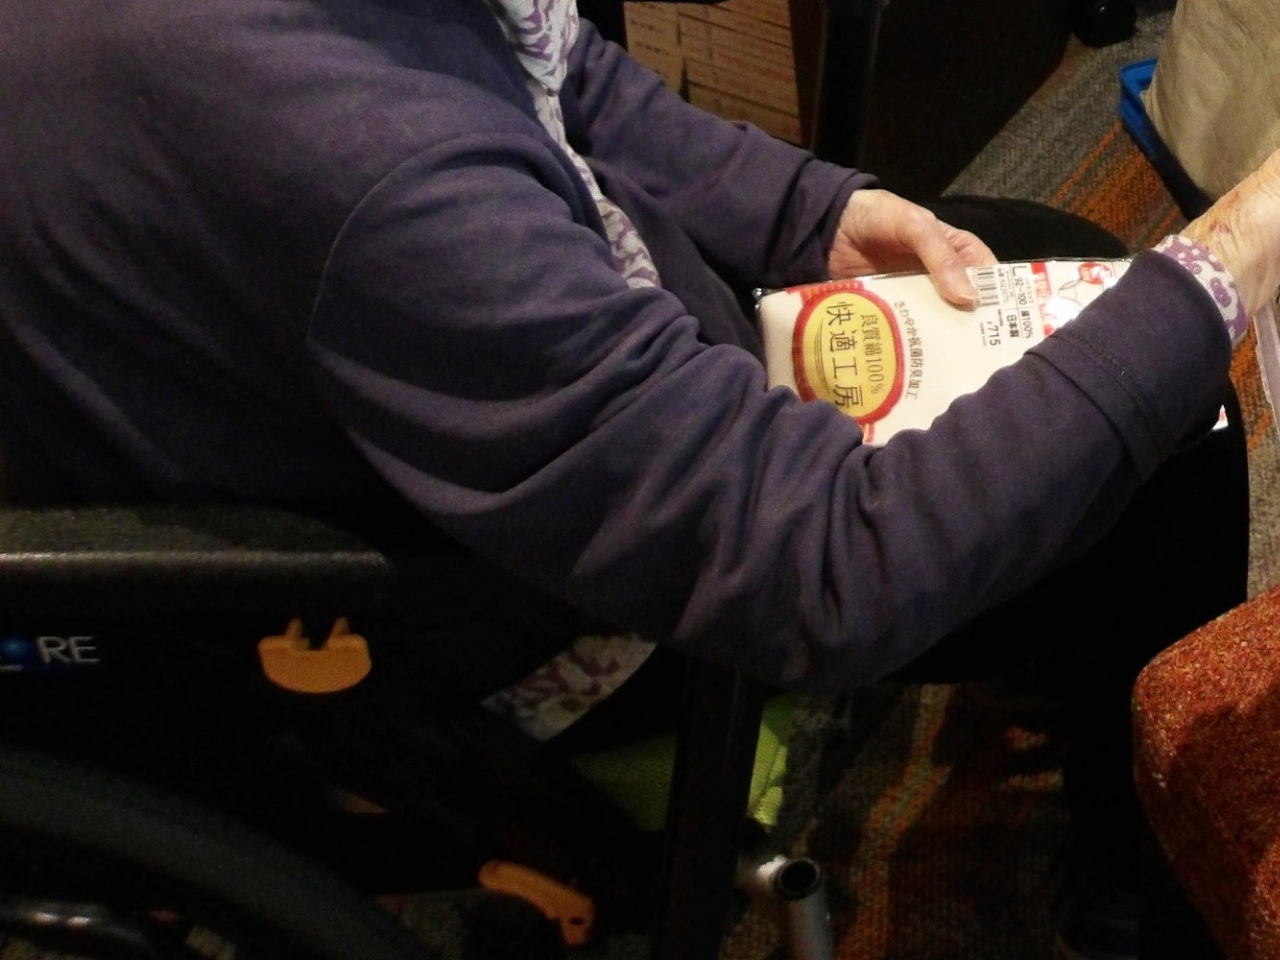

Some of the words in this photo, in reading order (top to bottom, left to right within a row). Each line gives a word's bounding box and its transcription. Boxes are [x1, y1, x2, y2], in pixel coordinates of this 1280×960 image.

[826, 301, 865, 409] 快適工房
[860, 314, 885, 395] 良質綿100%
